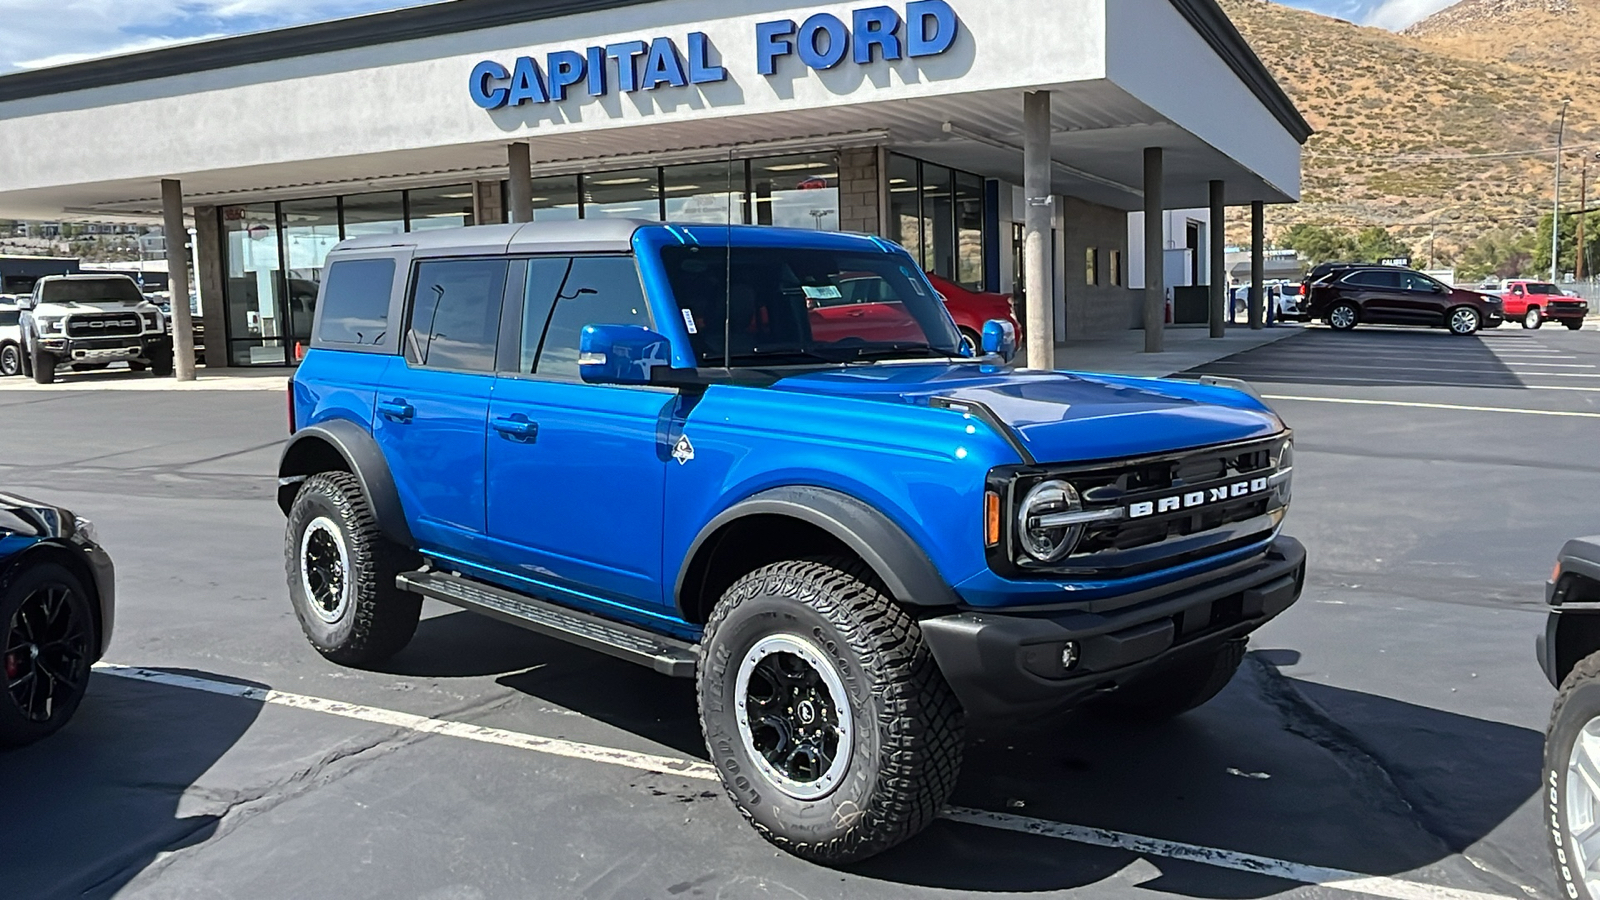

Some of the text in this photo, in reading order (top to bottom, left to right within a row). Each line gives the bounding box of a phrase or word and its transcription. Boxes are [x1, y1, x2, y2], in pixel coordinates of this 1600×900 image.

[469, 0, 958, 109] CAPITAL FORD
[70, 320, 136, 329] FORD
[1129, 477, 1267, 518] BRONCO
